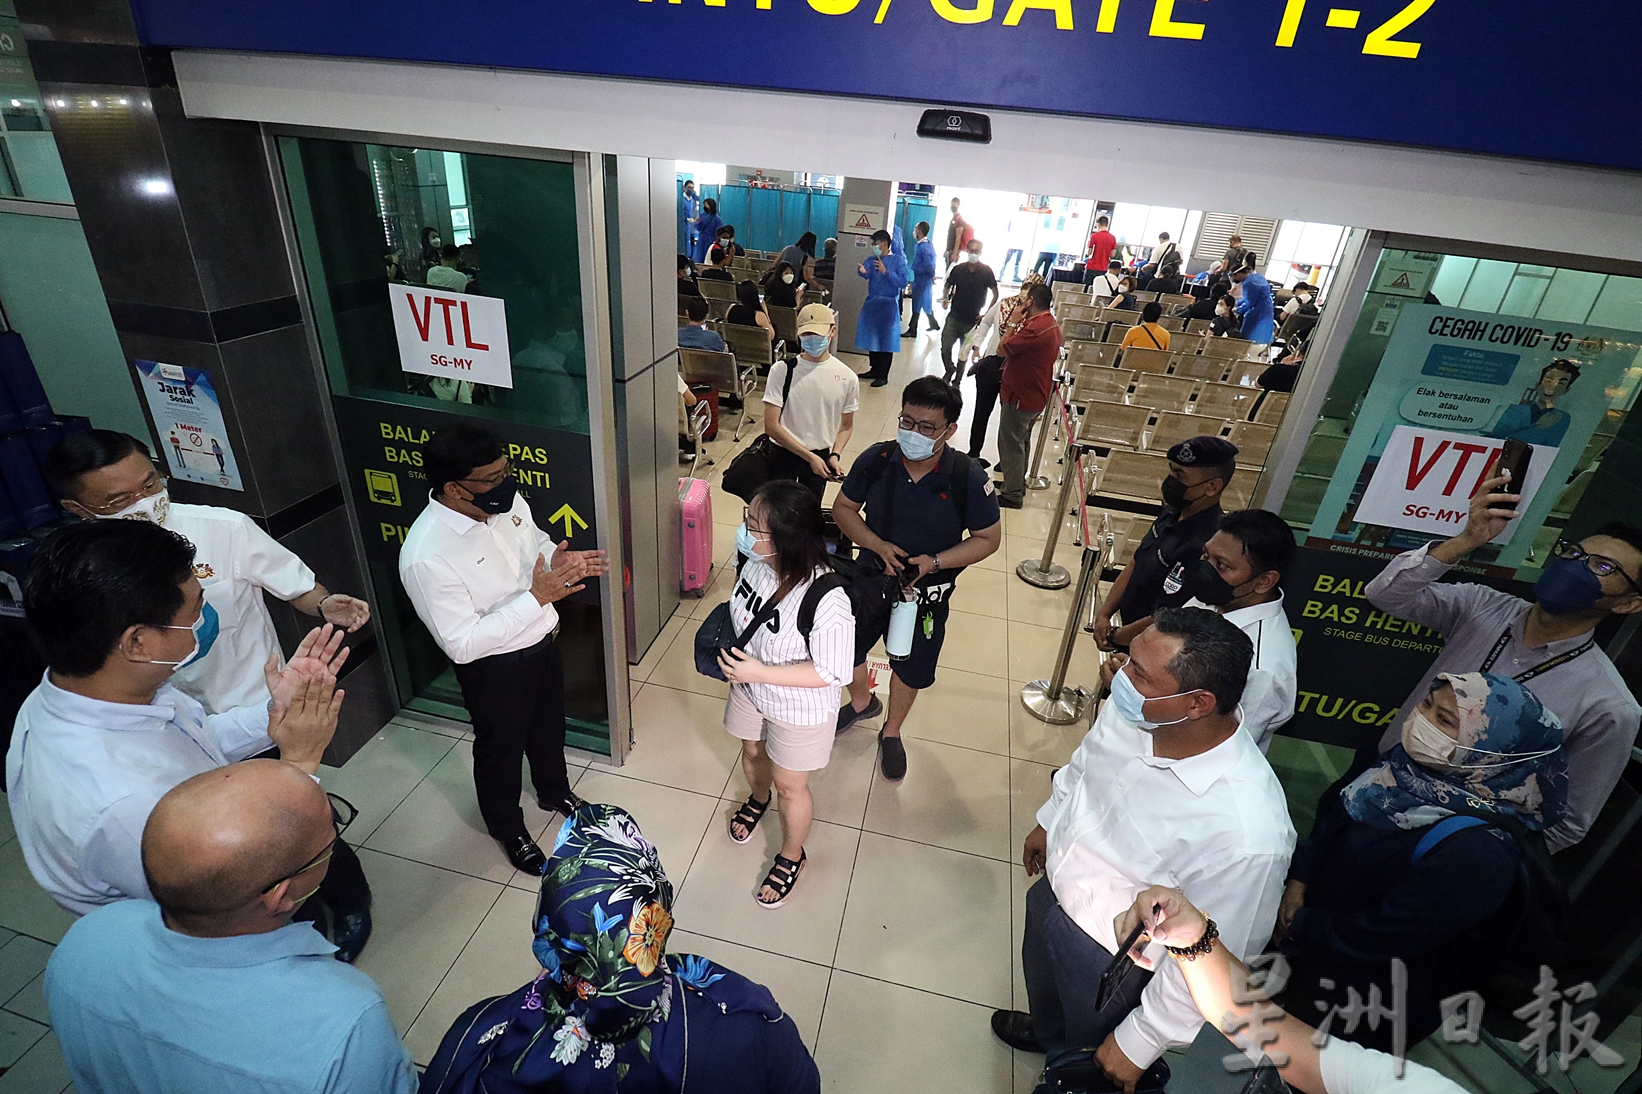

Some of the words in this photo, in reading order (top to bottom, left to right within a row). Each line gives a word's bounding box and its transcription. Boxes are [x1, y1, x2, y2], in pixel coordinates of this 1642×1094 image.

[406, 293, 489, 351] VTL
[1428, 316, 1489, 342] CEGAH
[430, 354, 473, 370] SG-MY
[157, 382, 196, 398] Jarak
[1416, 387, 1437, 397] Elak
[1437, 390, 1491, 405] bersalaman
[169, 394, 194, 405] Sosial
[1438, 401, 1459, 411] atau
[1417, 408, 1474, 424] bersentuhan
[180, 423, 202, 434] Meter
[384, 446, 424, 467] BAS
[1402, 504, 1468, 525] SG-MY
[1330, 544, 1358, 555] CRISIS
[1301, 599, 1360, 625] BAS
[1323, 626, 1363, 642] STAGE
[1364, 633, 1391, 647] BUS
